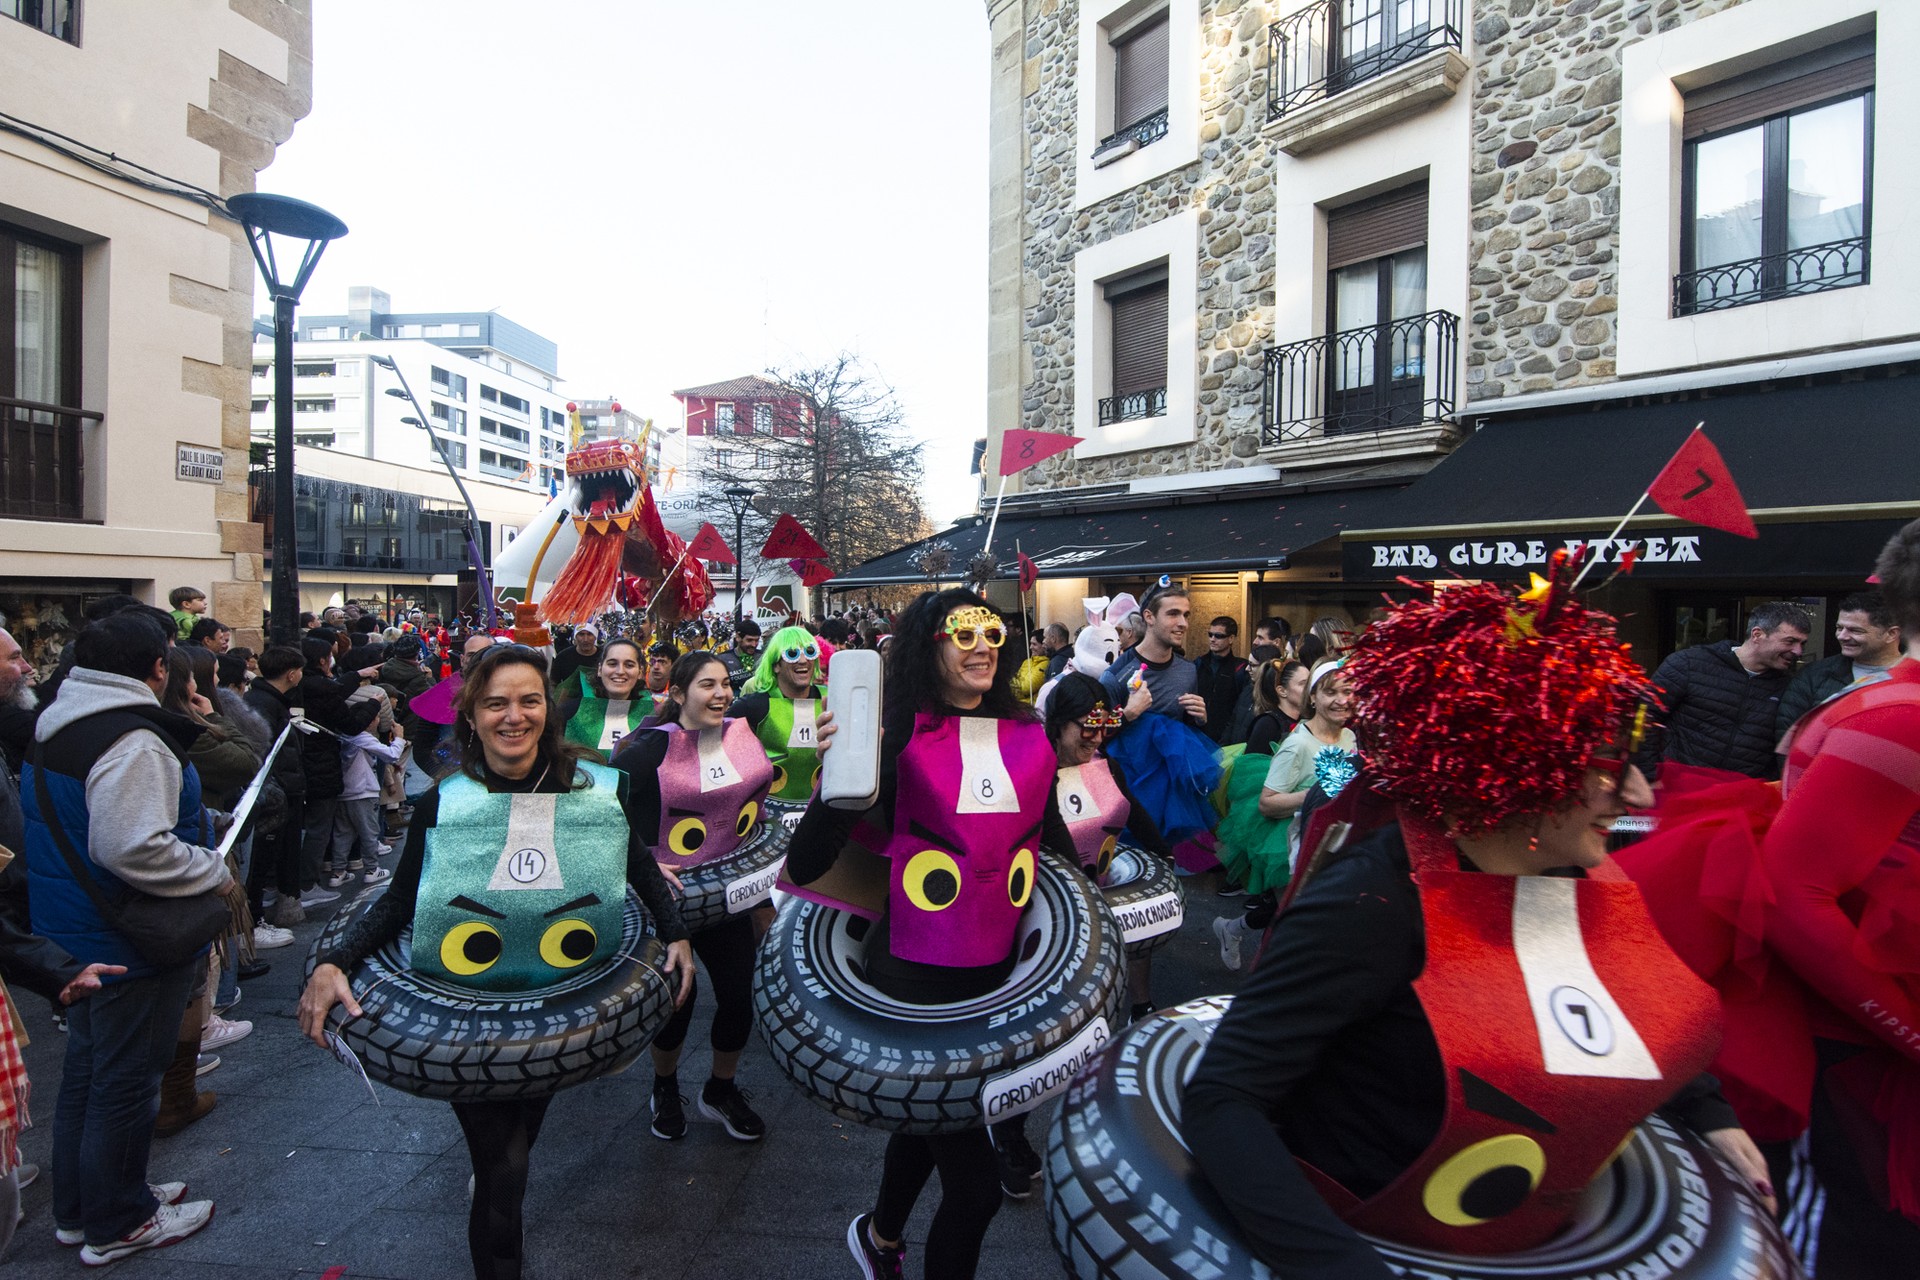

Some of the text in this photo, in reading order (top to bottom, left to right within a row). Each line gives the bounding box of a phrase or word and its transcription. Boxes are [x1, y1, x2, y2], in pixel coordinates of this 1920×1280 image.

[180, 450, 193, 462] CALLE
[1020, 438, 1036, 459] 8
[205, 468, 222, 480] KALEA
[1681, 467, 1714, 501] 7
[699, 536, 714, 551] 5
[778, 528, 799, 546] 21
[1371, 545, 1438, 569] BAR
[1449, 541, 1547, 567] GURE
[612, 731, 621, 744] 5
[799, 728, 811, 741] 11
[710, 767, 726, 779] 21
[981, 779, 994, 798] 8
[1069, 794, 1082, 815] 9
[518, 852, 535, 875] 14
[988, 868, 1091, 1030] PERFORMANCE
[802, 976, 832, 1000] HI
[508, 1000, 544, 1012] HI
[1563, 1003, 1594, 1040] 7
[1093, 1026, 1107, 1052] 8
